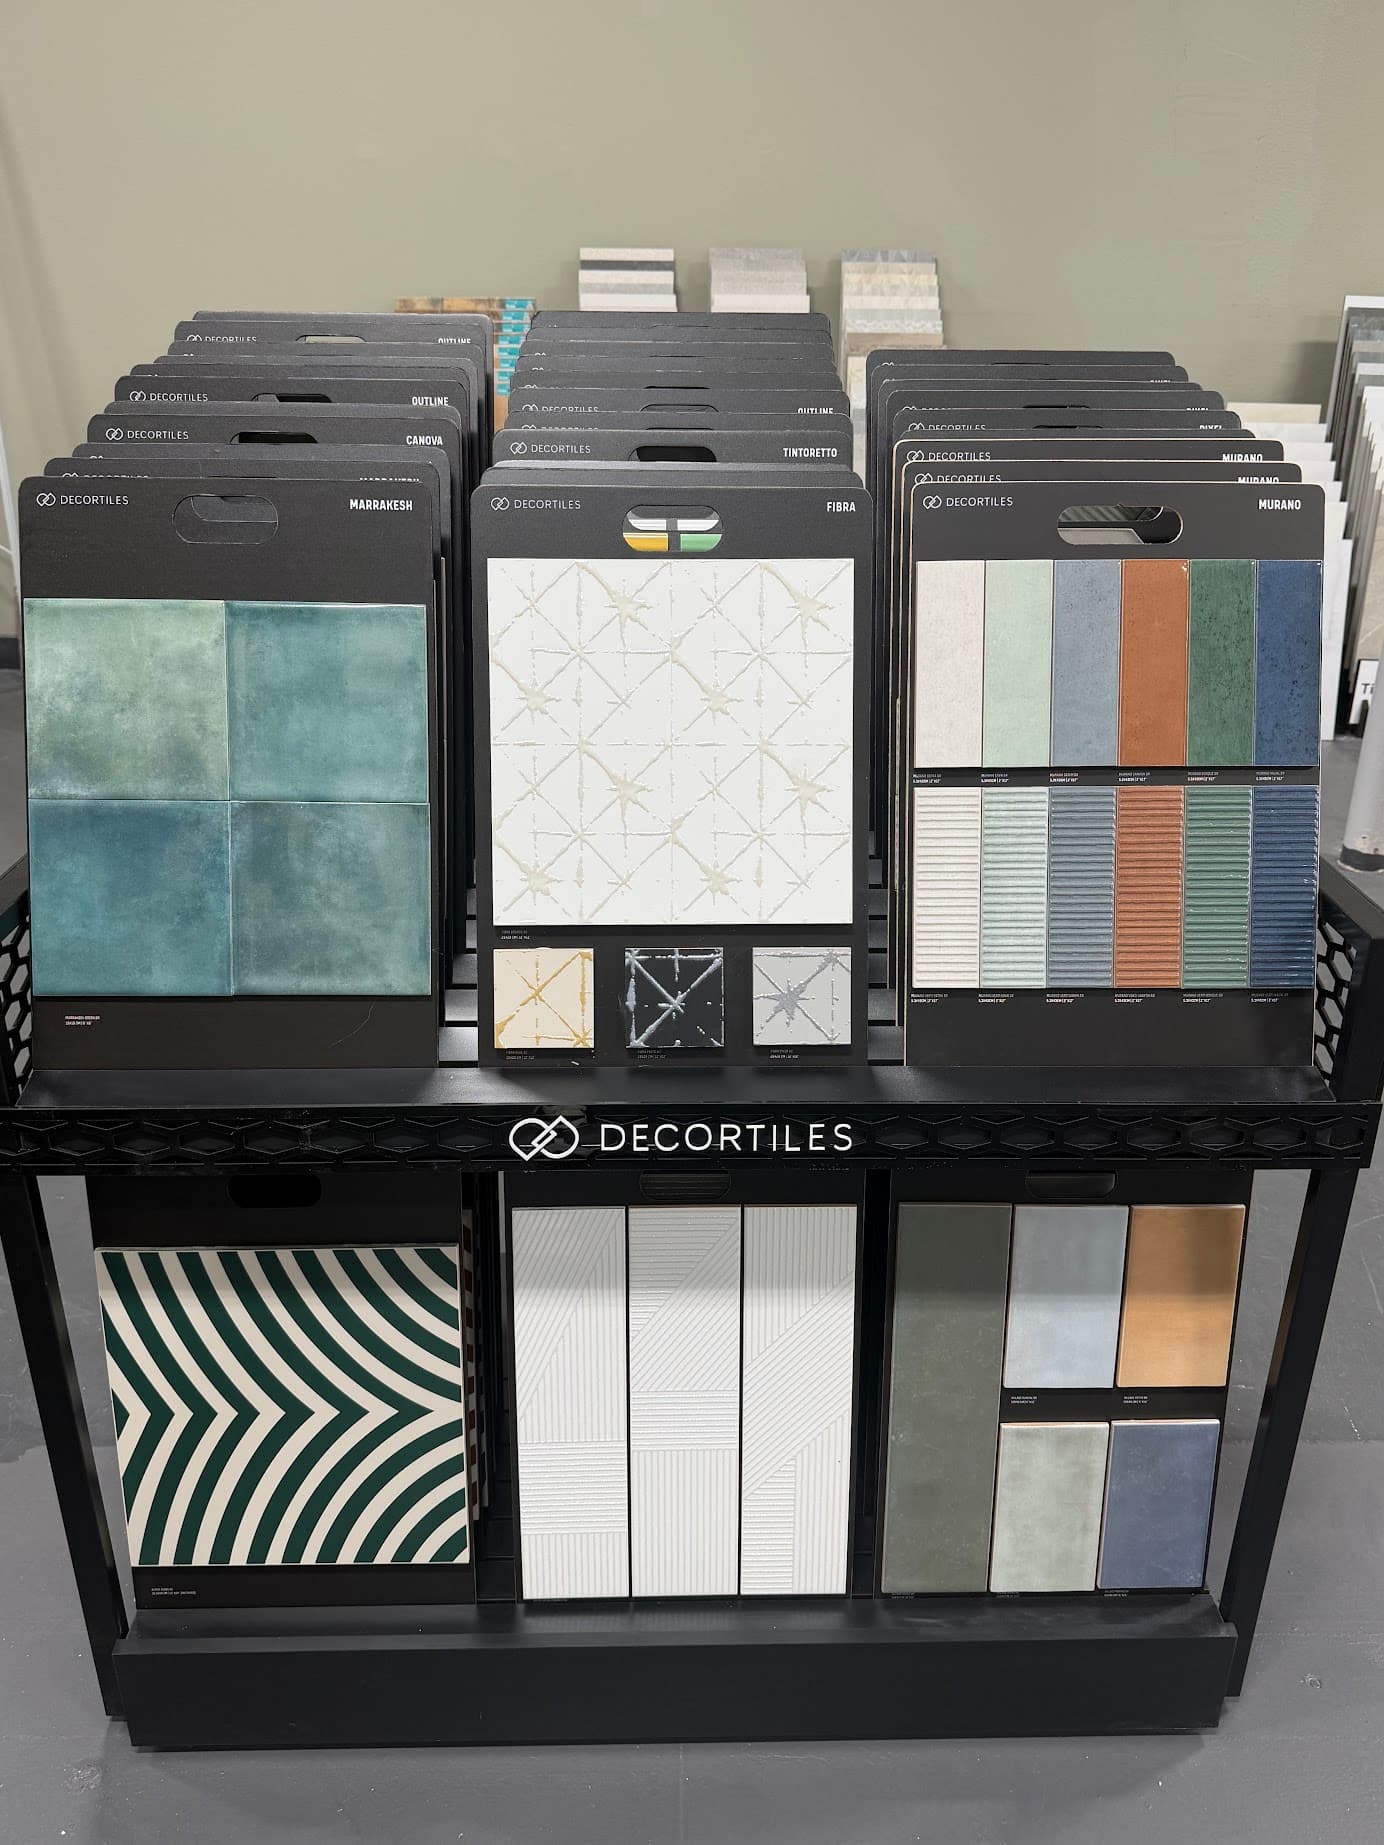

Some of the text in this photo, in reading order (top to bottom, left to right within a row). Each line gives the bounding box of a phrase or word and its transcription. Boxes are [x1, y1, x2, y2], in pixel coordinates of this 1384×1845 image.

[150, 393, 208, 402] DECORTILES
[412, 397, 449, 407] OUTLINE
[127, 430, 189, 440] DECORTILES
[406, 435, 443, 446] CANOVA
[531, 444, 591, 454] DECORTILES
[783, 447, 838, 458] TINTORETTO
[928, 452, 991, 461] DECORTILES
[1222, 453, 1263, 463] MURANO
[937, 474, 1001, 482] DECORTILES
[60, 495, 129, 505] DECORTILES
[350, 498, 413, 511] MARRAKESH
[514, 499, 581, 510] DECORTILES
[946, 496, 1013, 507] DECORTILES
[1258, 498, 1302, 511] MURANO
[826, 501, 856, 512] FIBRA
[600, 1123, 853, 1152] DECORTILES
